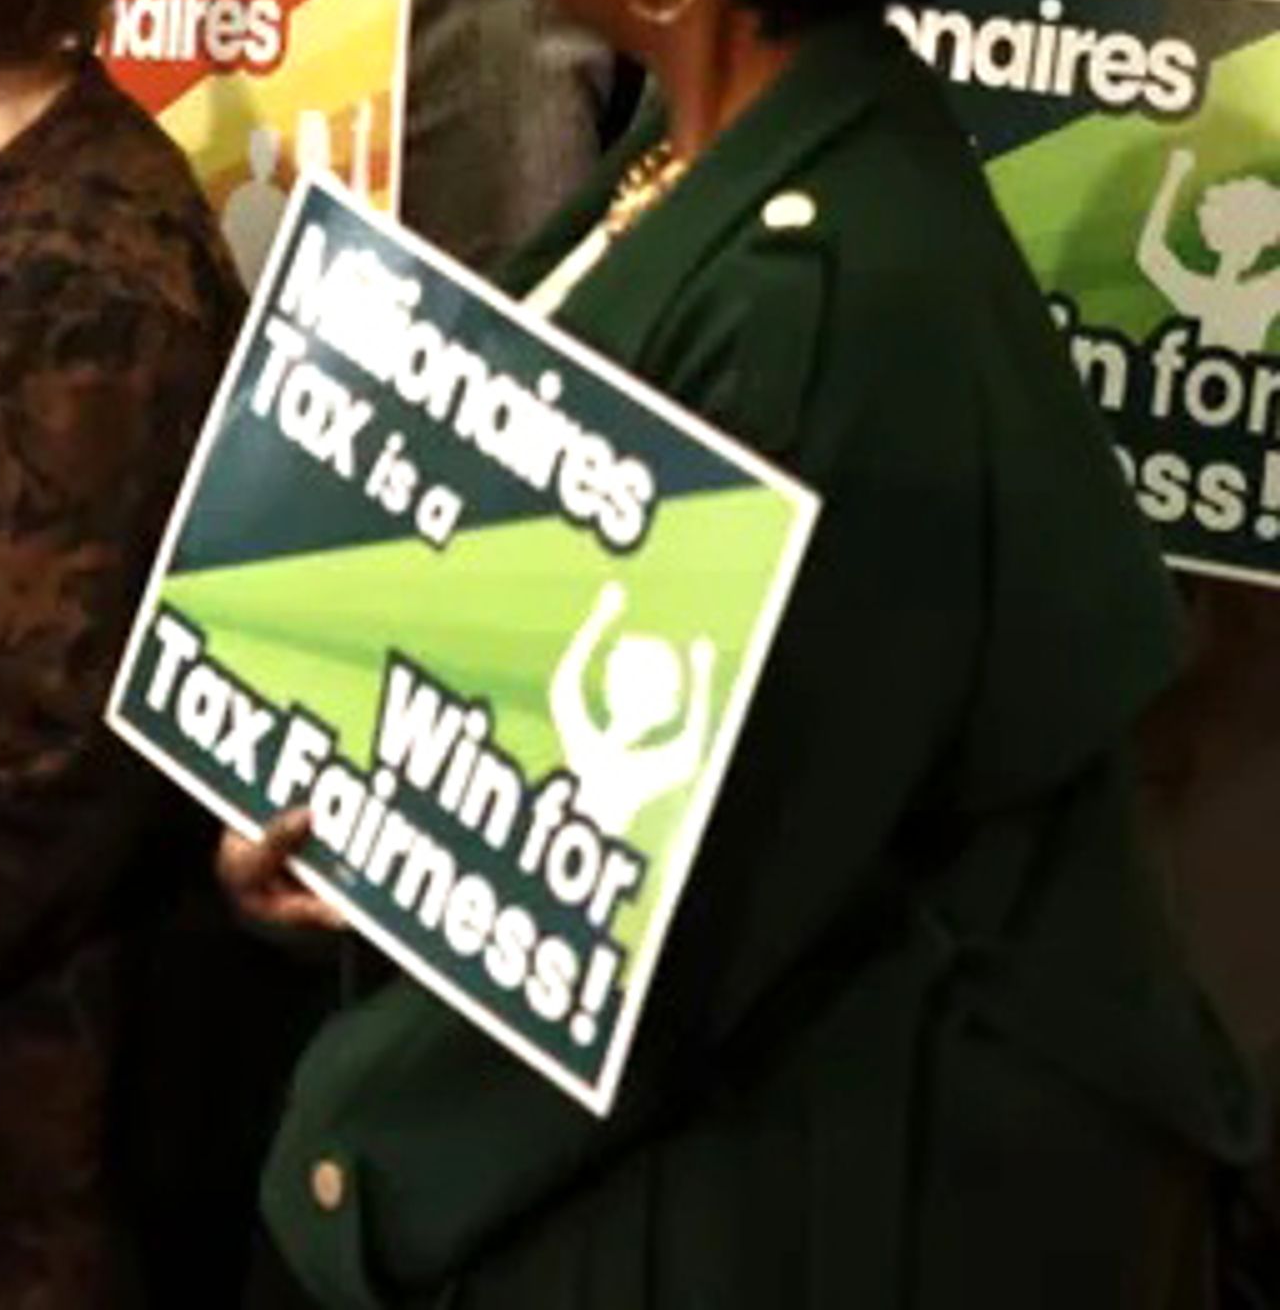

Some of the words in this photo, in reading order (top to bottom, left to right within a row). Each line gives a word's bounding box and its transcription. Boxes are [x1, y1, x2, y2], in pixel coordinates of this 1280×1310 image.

[247, 315, 375, 481] Tax
[363, 430, 420, 516] is
[414, 482, 465, 547] a
[279, 223, 654, 547] Millionaires
[144, 611, 274, 785] Tax
[266, 713, 620, 1048] Fairness!
[376, 661, 523, 852] Win
[517, 778, 641, 931] for
